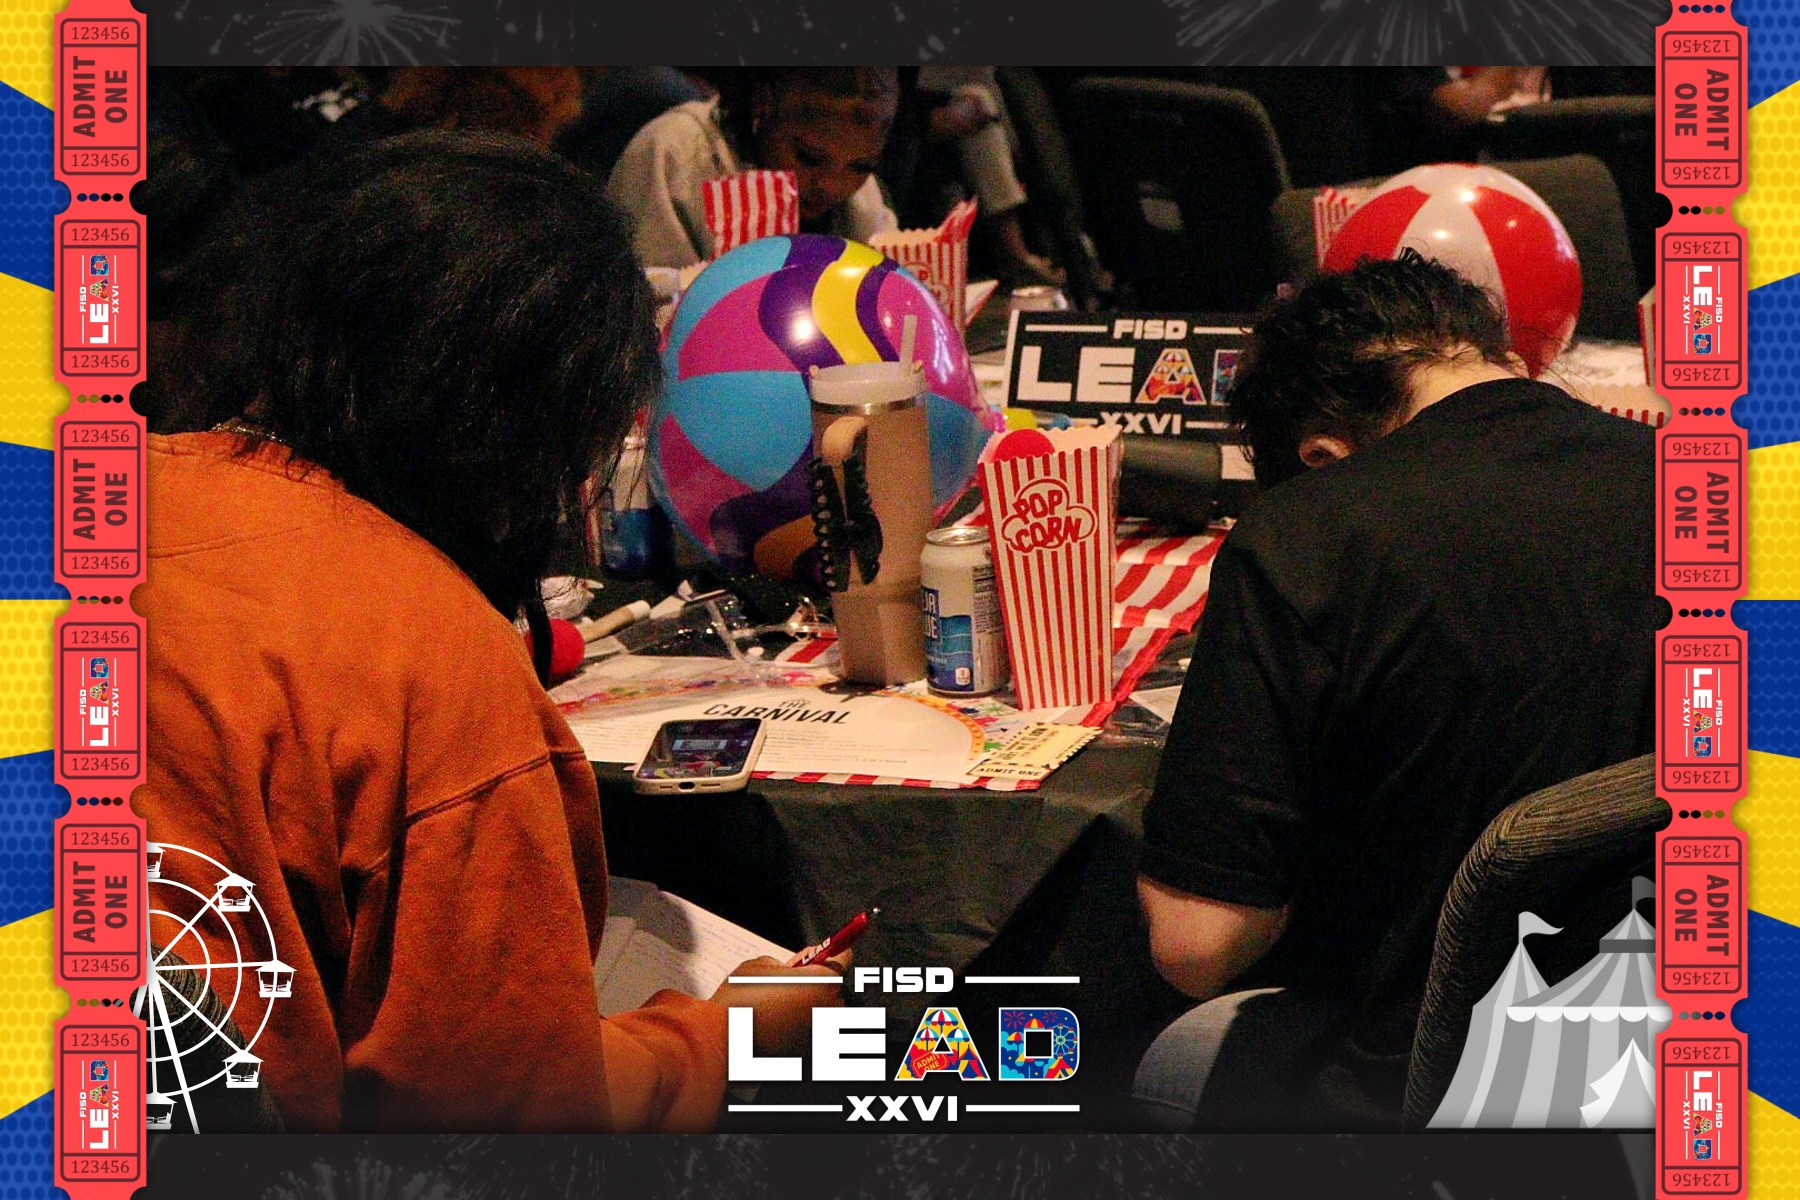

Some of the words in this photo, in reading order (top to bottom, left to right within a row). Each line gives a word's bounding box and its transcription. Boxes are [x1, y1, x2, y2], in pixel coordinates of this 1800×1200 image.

[1113, 319, 1188, 340] FISD
[1101, 412, 1182, 435] XXVI
[1012, 489, 1063, 525] POP
[1015, 516, 1082, 553] CORN
[703, 704, 851, 724] CARNIVAL
[778, 700, 808, 708] THE
